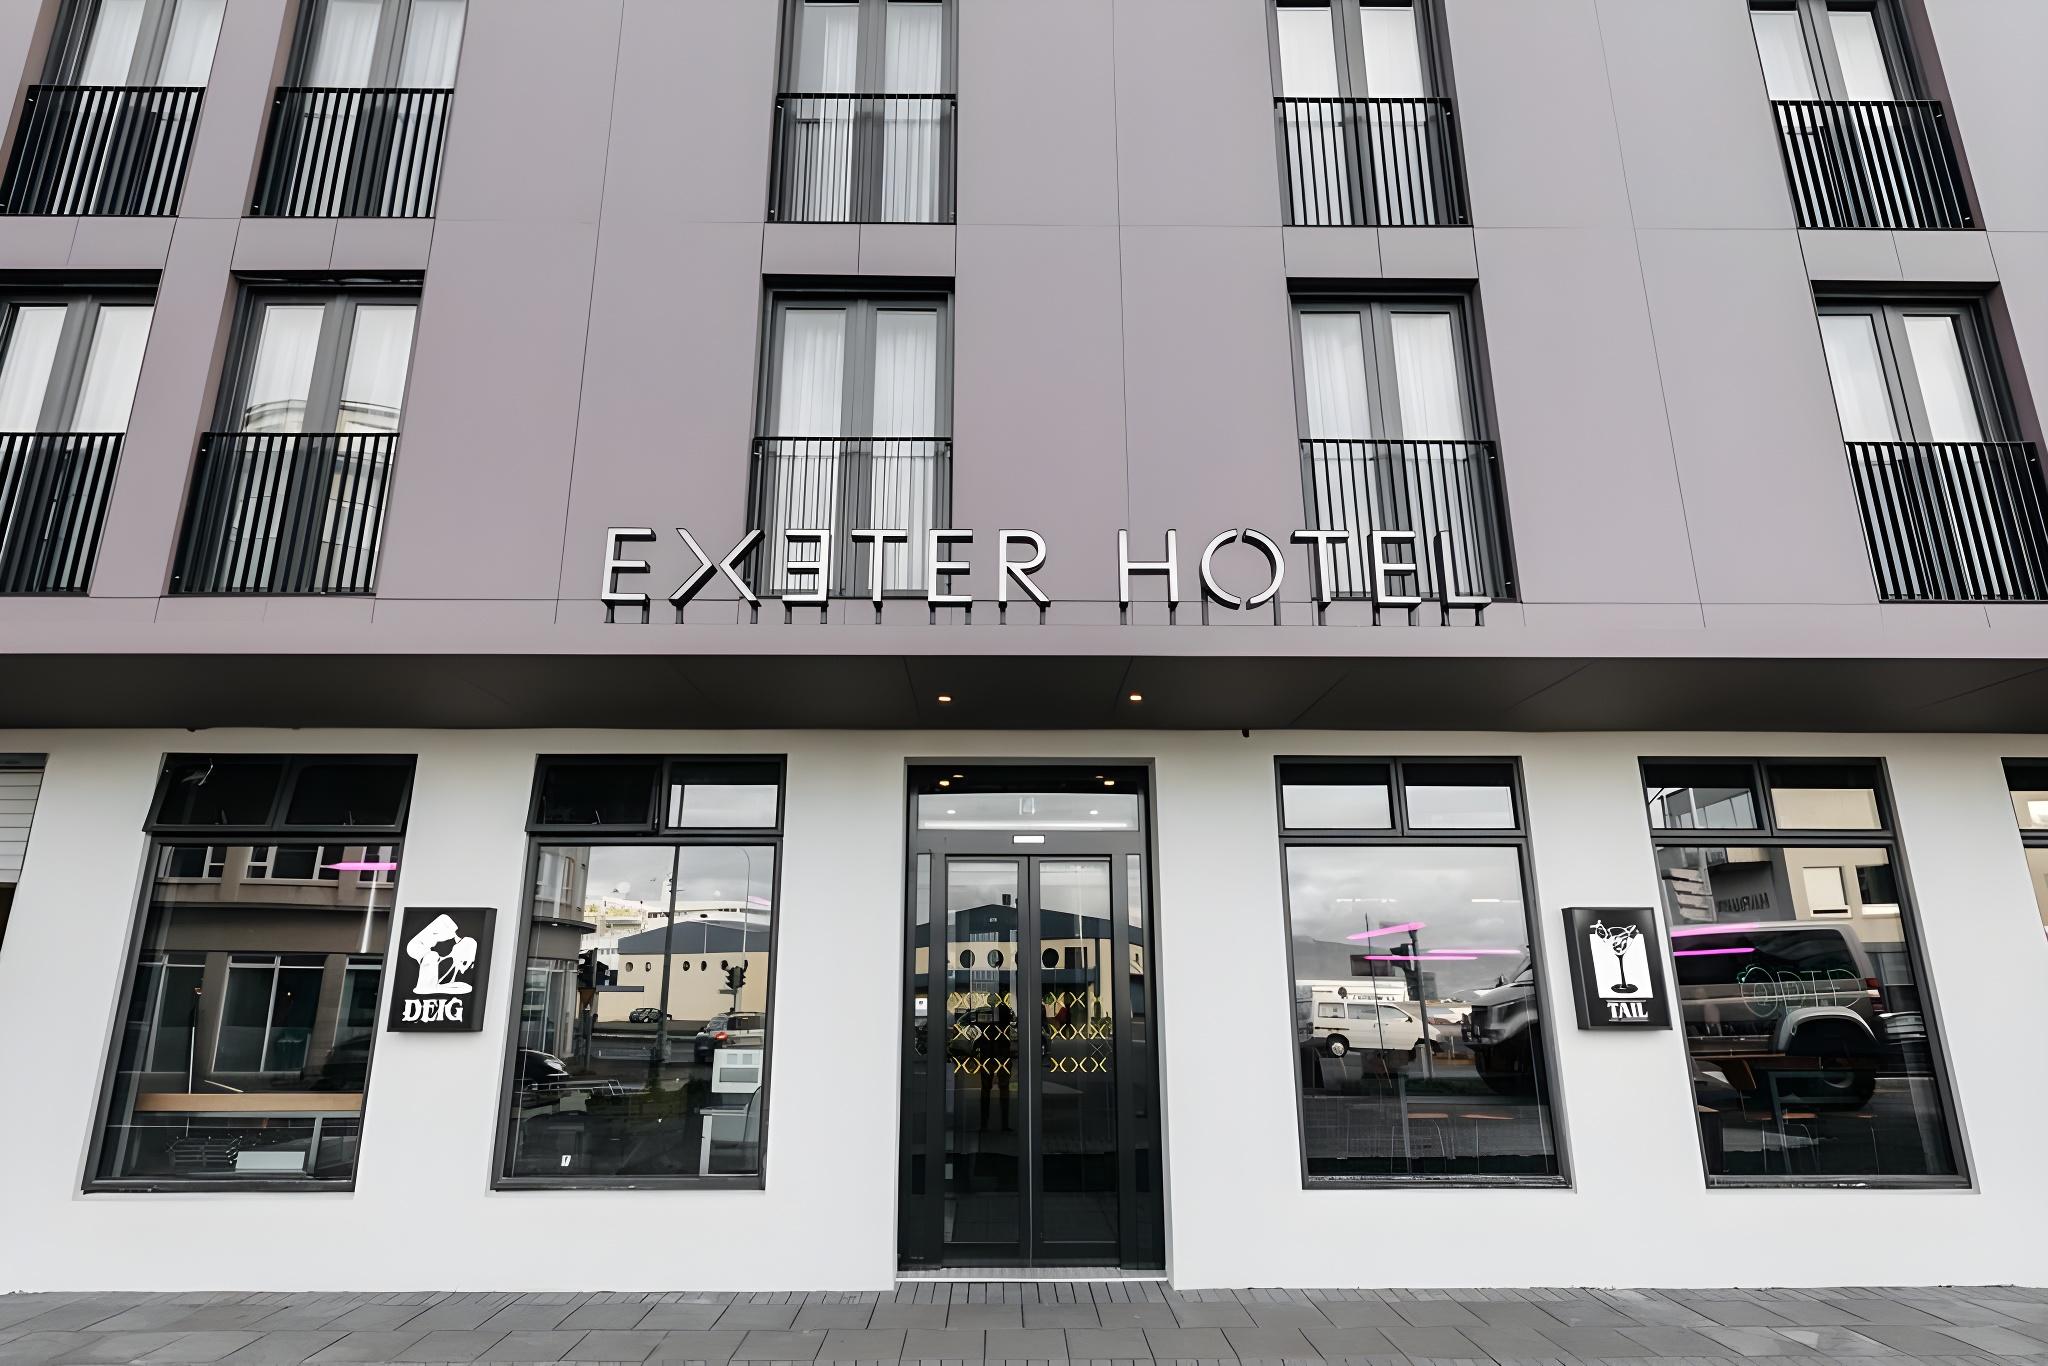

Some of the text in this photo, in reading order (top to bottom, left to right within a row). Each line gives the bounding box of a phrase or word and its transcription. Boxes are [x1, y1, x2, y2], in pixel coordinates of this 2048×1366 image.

[601, 527, 1491, 610] EXETER HOTEL
[402, 997, 463, 1023] DEIG
[1607, 1002, 1648, 1018] TAIL
